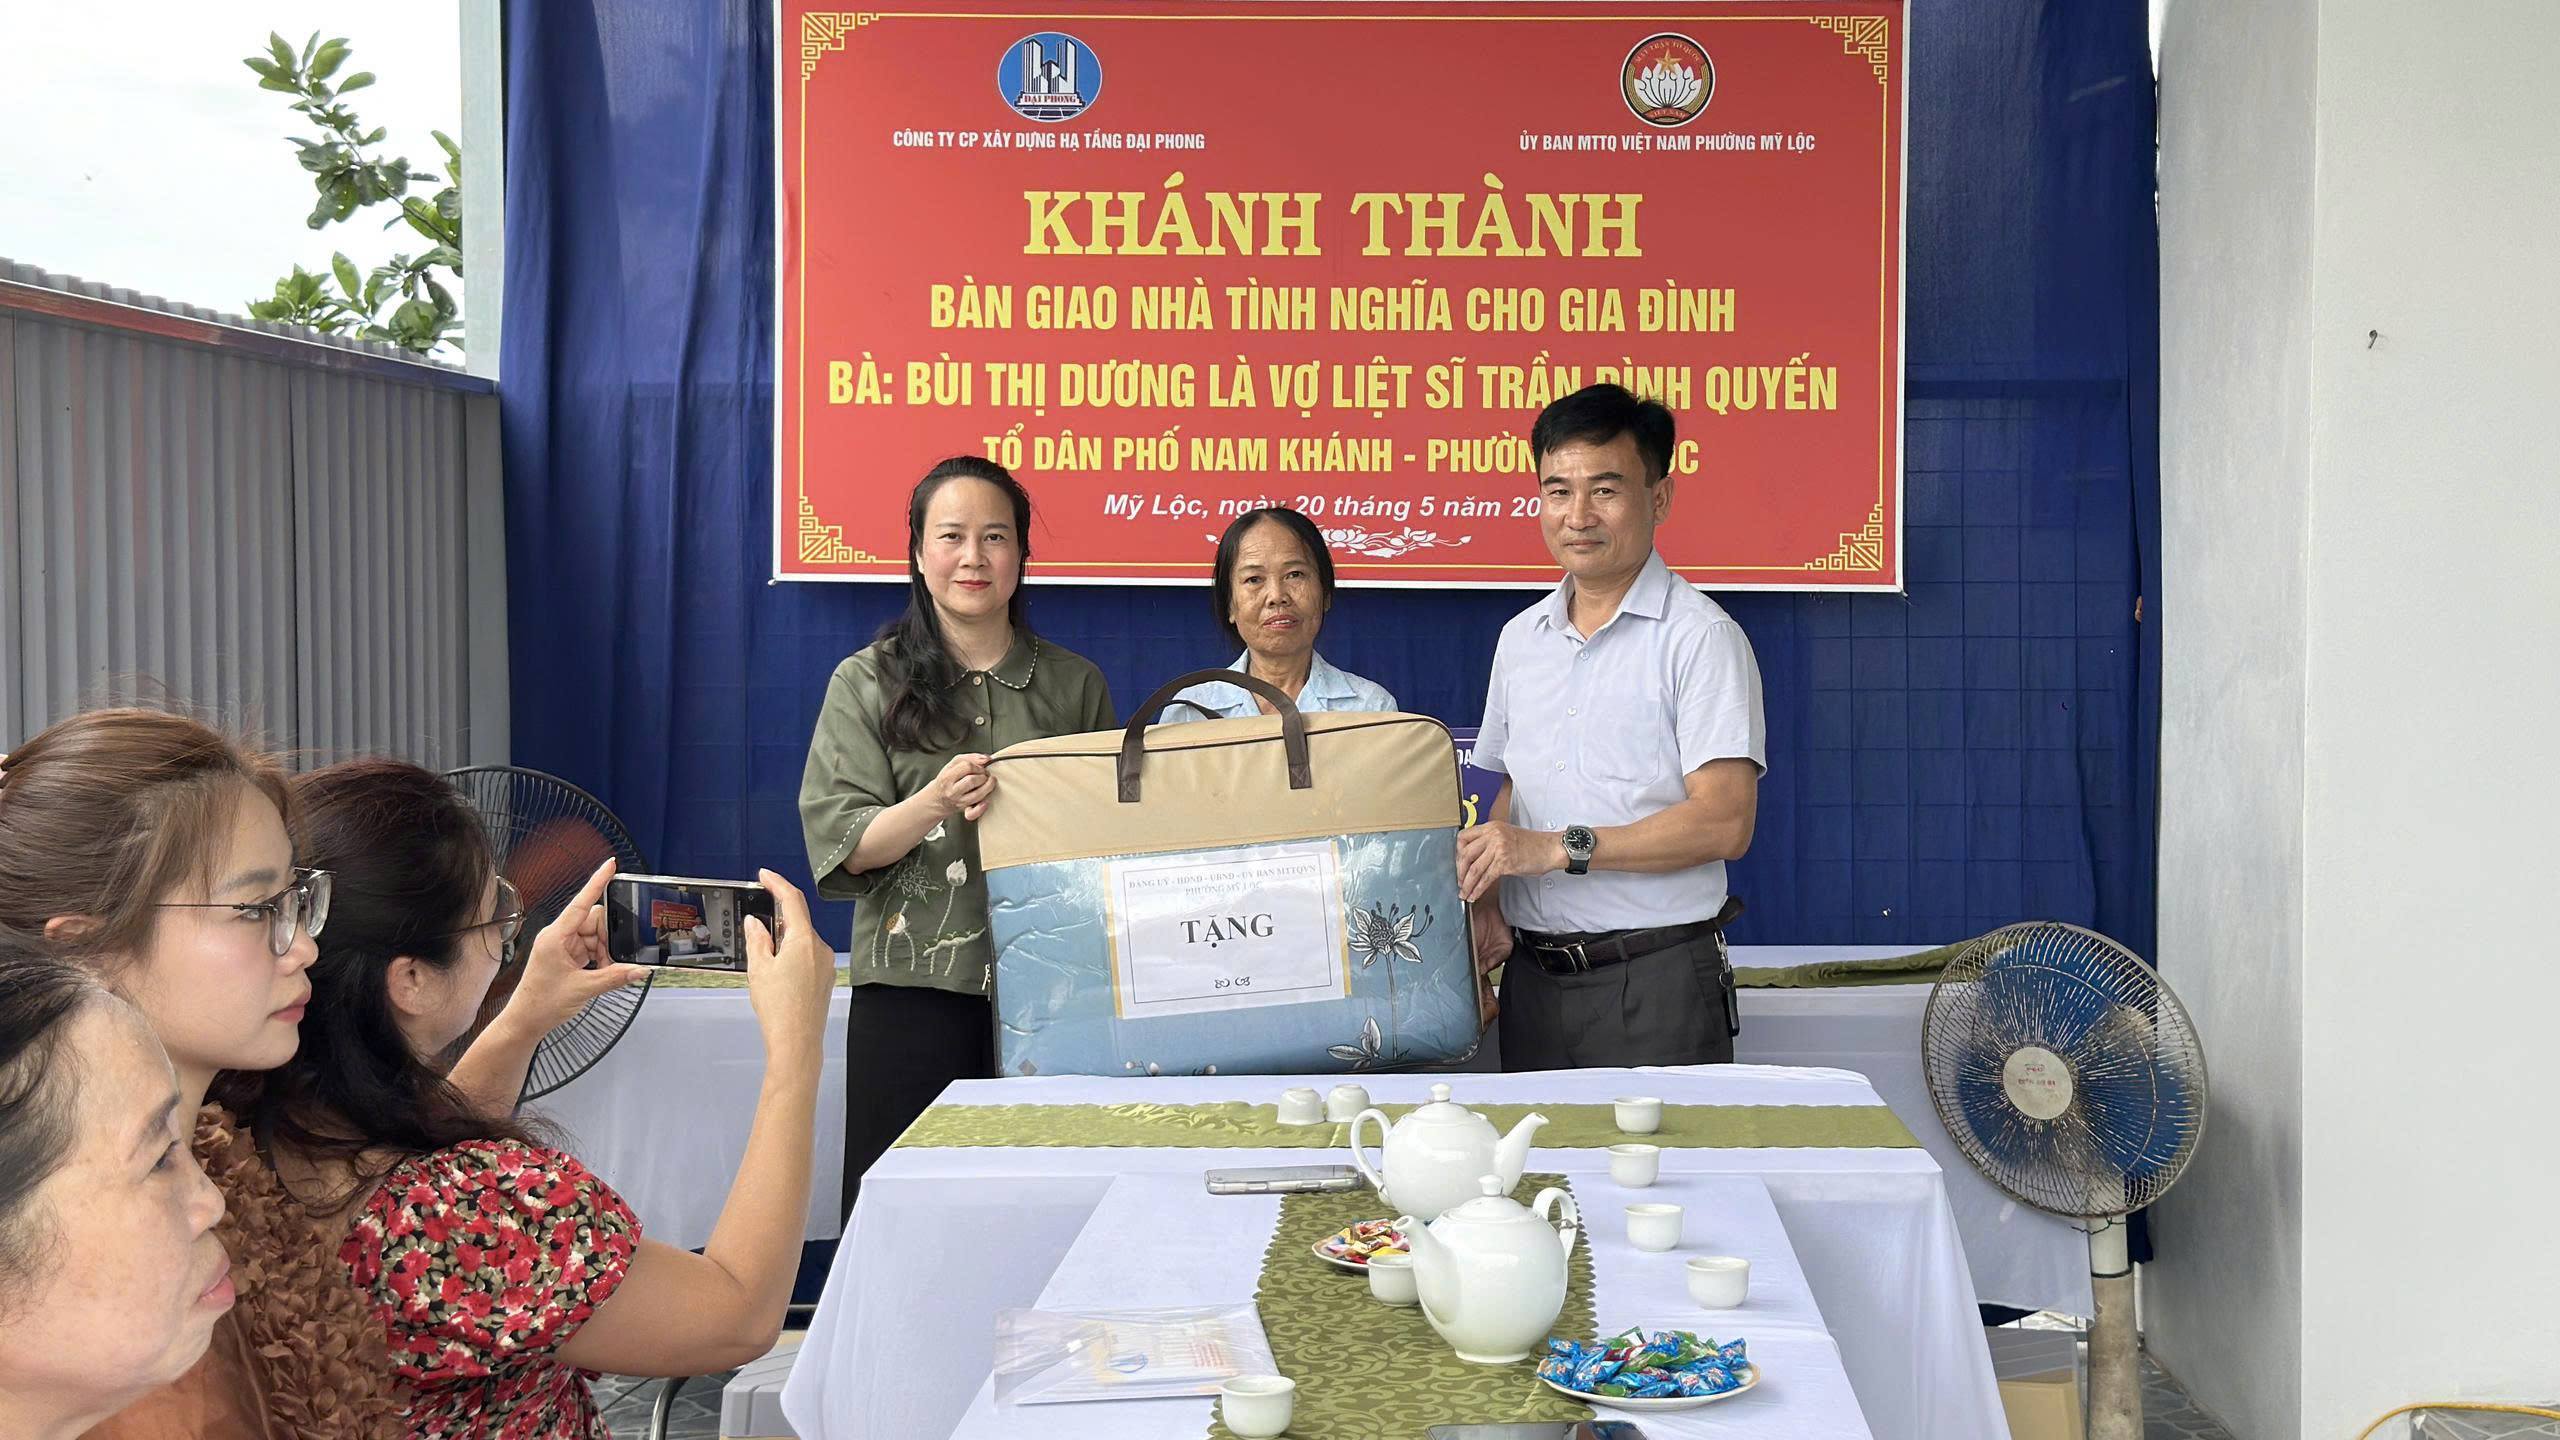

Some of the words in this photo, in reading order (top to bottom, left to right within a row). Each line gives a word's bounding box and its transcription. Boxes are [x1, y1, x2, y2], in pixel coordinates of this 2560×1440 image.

[1044, 95, 1076, 103] PHONG
[893, 128, 934, 147] CÔNG
[938, 131, 955, 147] TY
[959, 132, 979, 147] CP
[983, 128, 1011, 148] XÂY
[1016, 131, 1056, 151] DỰNG
[1060, 133, 1080, 152] HẠ
[1083, 128, 1122, 148] TẦNG
[1126, 134, 1151, 152] ĐẠI
[1155, 134, 1205, 149] PHONG
[1519, 129, 1538, 151] ỦY
[1543, 135, 1573, 151] BAN
[1577, 135, 1617, 151] MTTQ
[1621, 131, 1652, 154] VIỆT
[1657, 135, 1691, 151] NAM
[1695, 130, 1755, 151] PHƯỜNG
[1760, 132, 1782, 151] MỸ
[1787, 131, 1815, 154] LỘC
[1023, 171, 1322, 256] KHÁNH
[1350, 172, 1643, 257] THÀNH
[930, 275, 1013, 329] BÀN
[1026, 284, 1118, 330] GIAO
[1131, 277, 1214, 330] NHÀ
[1226, 277, 1316, 331] TÌNH
[1330, 278, 1453, 332] NGHĨA
[1466, 287, 1545, 332] CHO
[1559, 287, 1626, 333] GIA
[1637, 279, 1735, 332] ĐÌNH
[828, 351, 893, 405] BÀ:
[906, 352, 972, 406] BÙI
[984, 361, 1046, 417] THỊ
[1059, 358, 1195, 408] DƯƠNG
[1209, 354, 1257, 408] LÀ
[1268, 360, 1320, 418] VỢ
[1332, 356, 1413, 419] LIỆT
[1425, 356, 1467, 409] SĨ
[1476, 350, 1581, 409] TRẦN
[1705, 352, 1837, 416] QUYẾN
[982, 422, 1025, 471] TỔ
[1033, 429, 1102, 471] DÂN
[1113, 424, 1181, 472] PHỐ
[1190, 437, 1268, 472] NAM
[1279, 430, 1393, 472] KHÁNH
[1403, 454, 1416, 462] -
[1427, 430, 1536, 473] PHƯỜN
[1103, 494, 1145, 520] Mỹ
[1151, 493, 1209, 520] Lộc,
[1295, 495, 1326, 516] 20
[1333, 495, 1411, 522] tháng
[1419, 496, 1435, 517] 5
[1443, 496, 1501, 517] năm
[1510, 496, 1542, 518] 20
[1180, 913, 1275, 949] TẶNG
